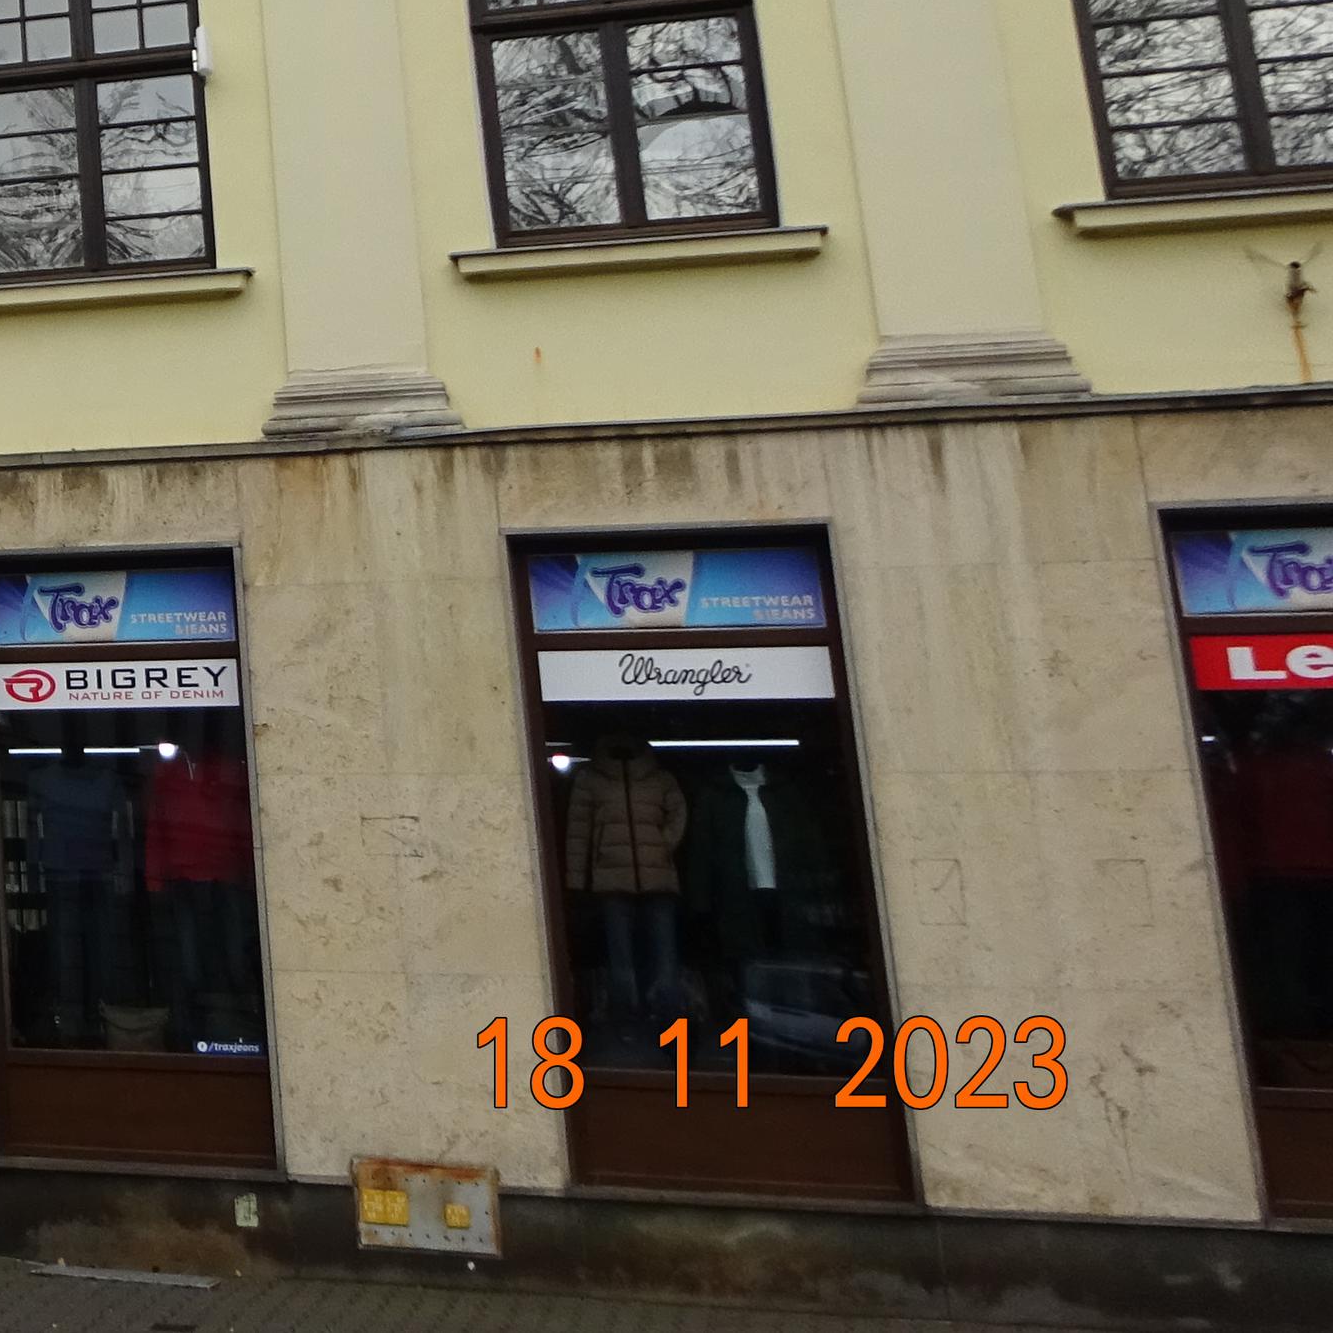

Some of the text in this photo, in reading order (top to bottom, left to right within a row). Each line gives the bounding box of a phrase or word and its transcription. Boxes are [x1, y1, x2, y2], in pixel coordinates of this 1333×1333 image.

[1247, 540, 1333, 597] Tra
[699, 595, 814, 609] STREETWEAR
[130, 611, 227, 624] STREETWEAR
[619, 653, 753, 696] Wrangler
[1226, 645, 1333, 681] Le
[66, 665, 228, 689] BIGREY
[69, 689, 224, 701] NATURE OF DENIM
